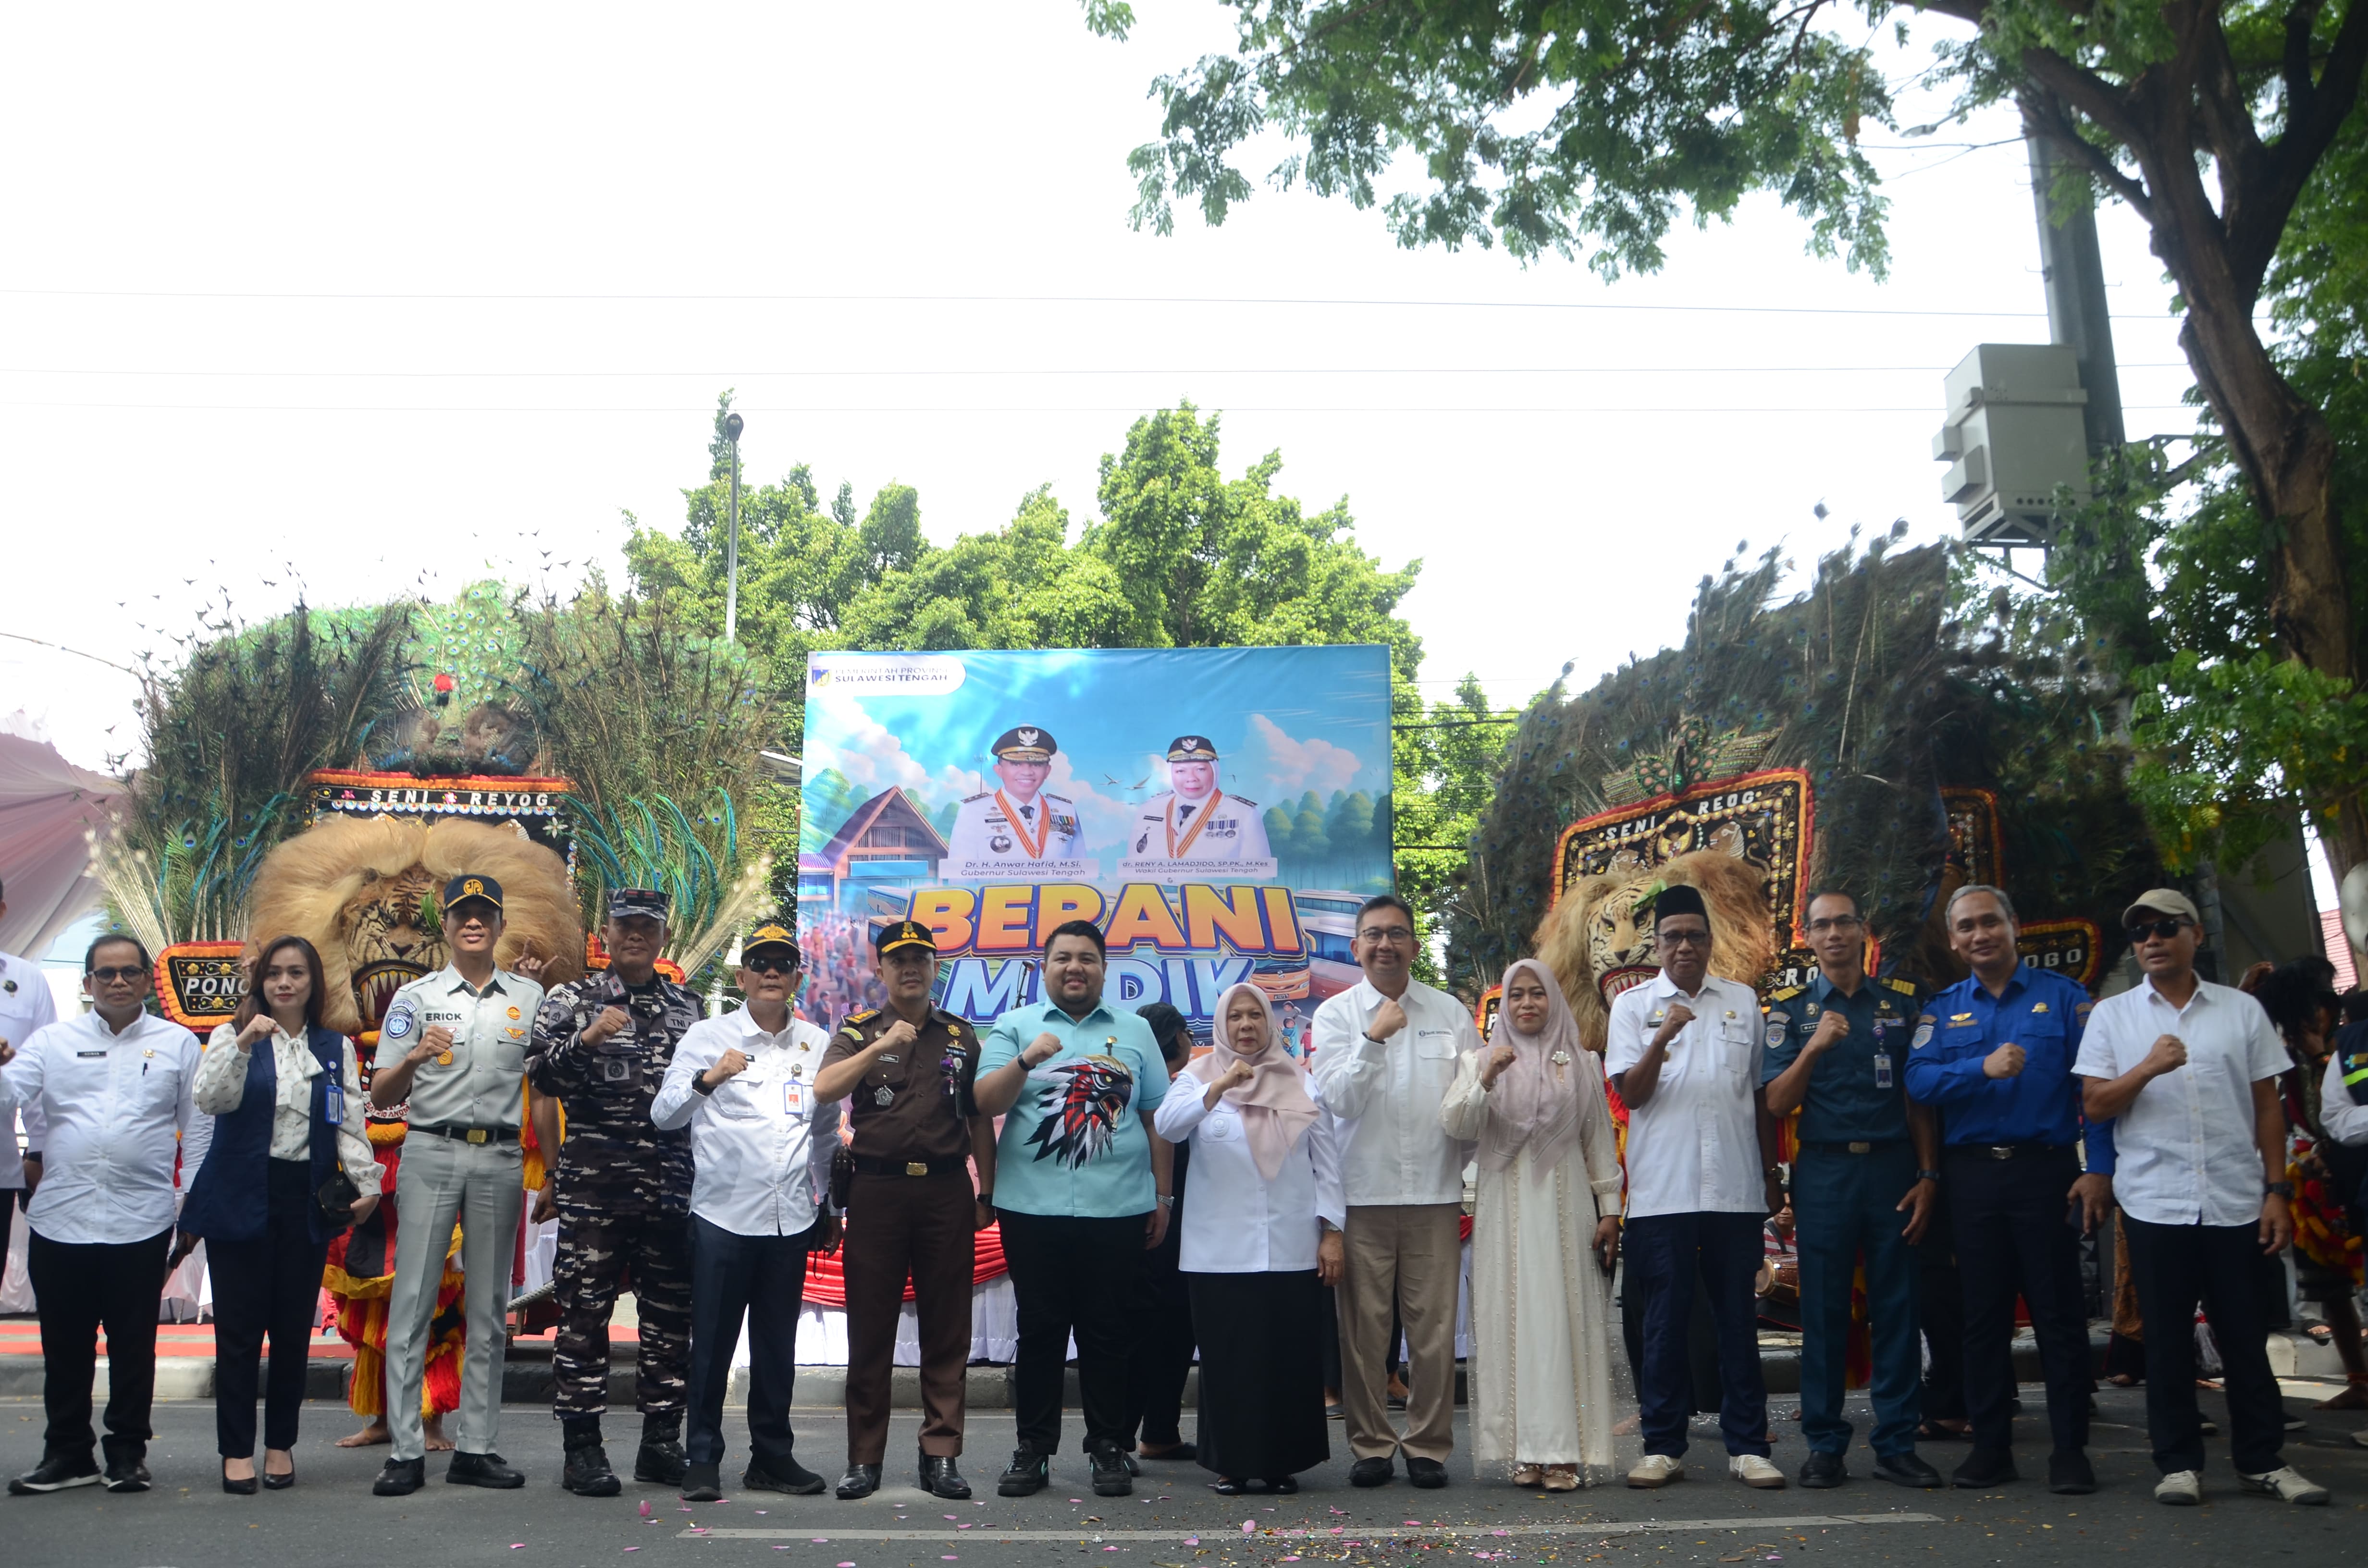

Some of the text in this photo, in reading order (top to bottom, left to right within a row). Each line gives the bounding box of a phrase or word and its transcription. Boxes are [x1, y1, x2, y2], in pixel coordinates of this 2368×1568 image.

[370, 790, 549, 806] SENI REYOG
[1605, 790, 1754, 841] SENI REOG
[908, 883, 1303, 953] BERANI
[426, 1013, 462, 1021] ERICK
[670, 1018, 686, 1028] TNI
